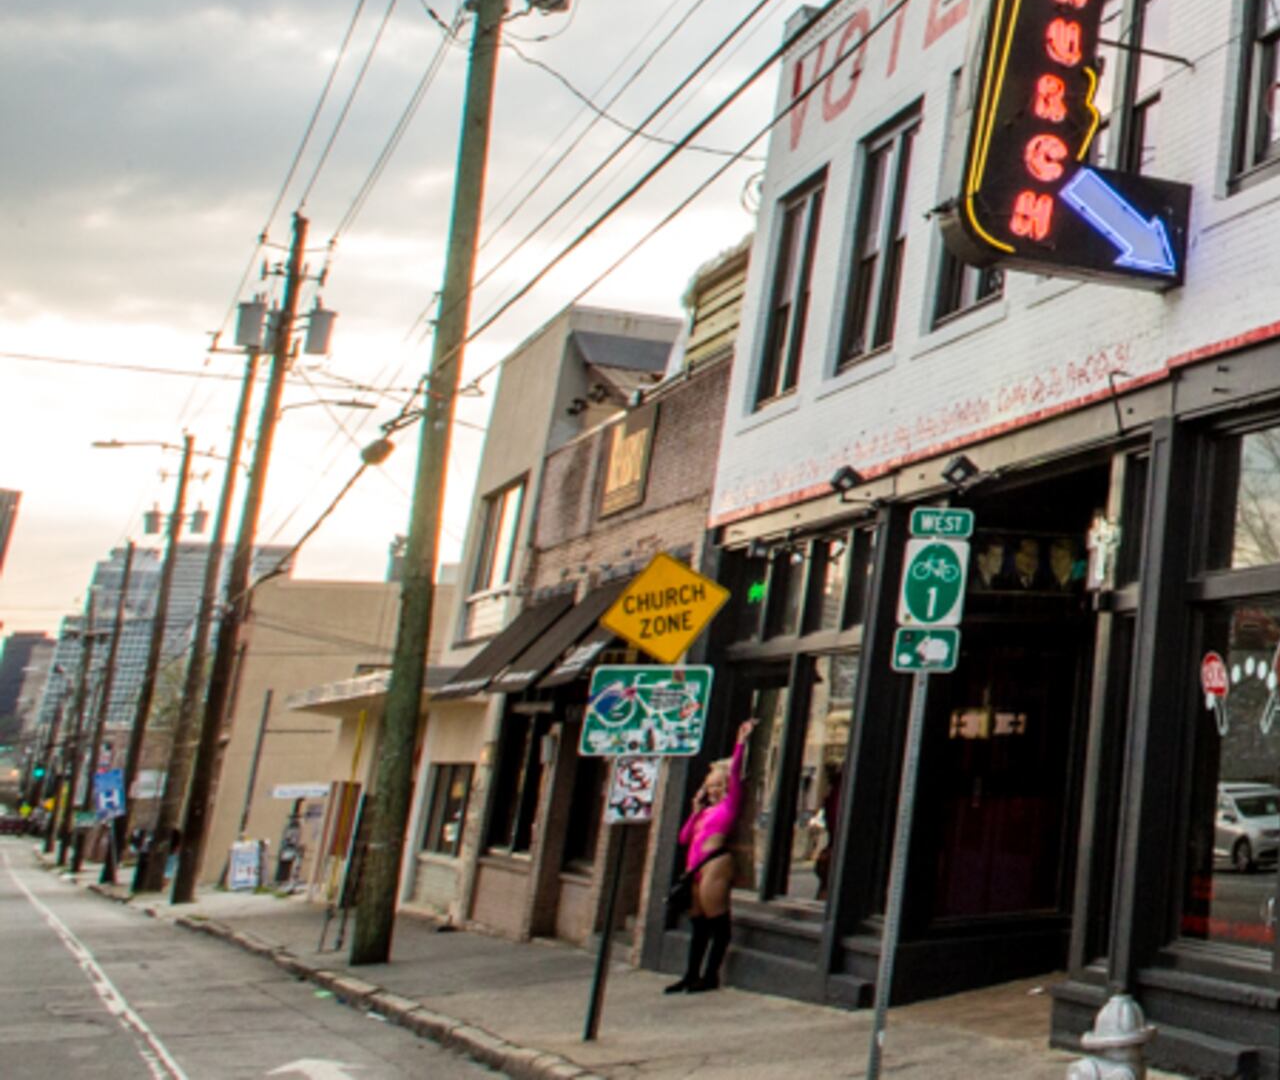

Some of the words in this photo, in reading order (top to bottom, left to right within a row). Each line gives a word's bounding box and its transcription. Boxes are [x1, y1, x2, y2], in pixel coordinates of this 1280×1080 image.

[920, 513, 963, 532] WEST
[622, 583, 706, 615] CHURCH
[926, 585, 938, 620] 1
[639, 610, 693, 639] ZONE
[98, 789, 121, 809] H
